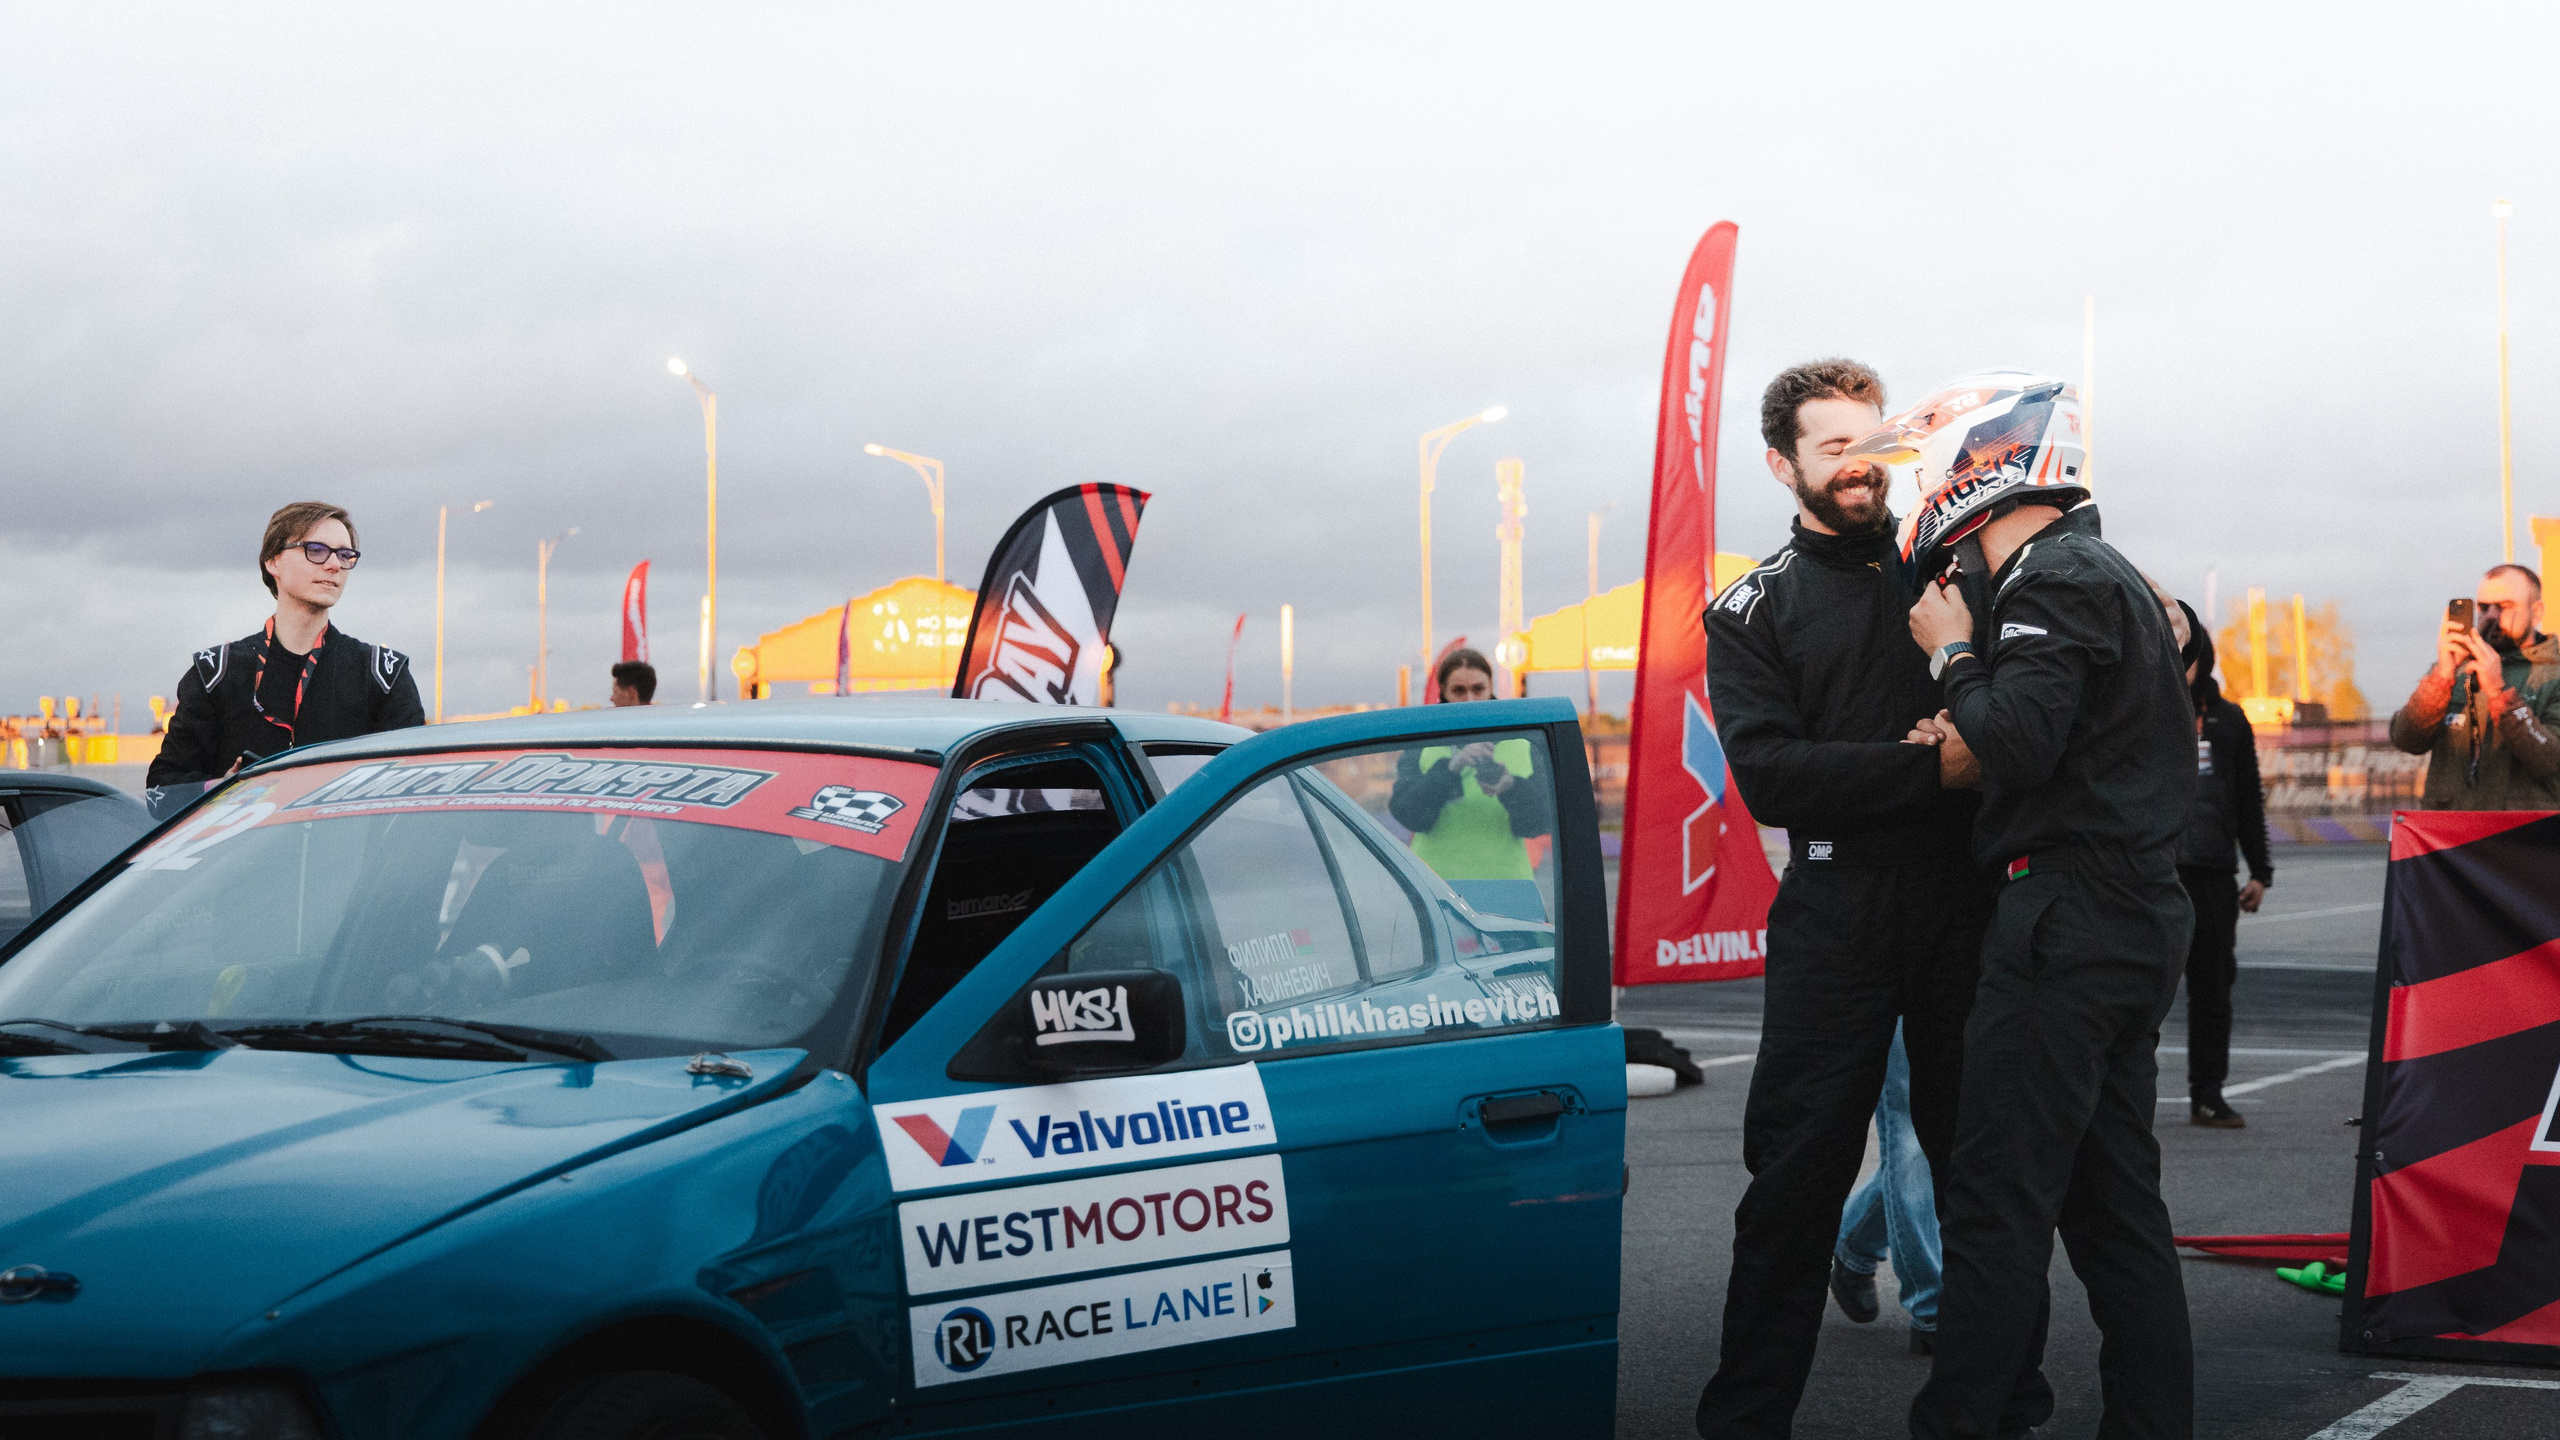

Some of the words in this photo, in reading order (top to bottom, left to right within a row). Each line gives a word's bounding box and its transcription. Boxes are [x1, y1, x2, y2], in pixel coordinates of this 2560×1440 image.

[1728, 585, 1754, 612] OMP
[1809, 844, 1833, 858] OMP
[1228, 930, 1296, 970] ФИЛИПП
[1238, 961, 1333, 1009] ХАСИНЕВИЧ
[1268, 985, 1561, 1049] philkhasinevich
[1008, 1099, 1251, 1158] Valvoline
[916, 1180, 1274, 1268] WESTMOTORS
[1005, 1301, 1113, 1349] RACE
[1125, 1281, 1235, 1330] LANE
